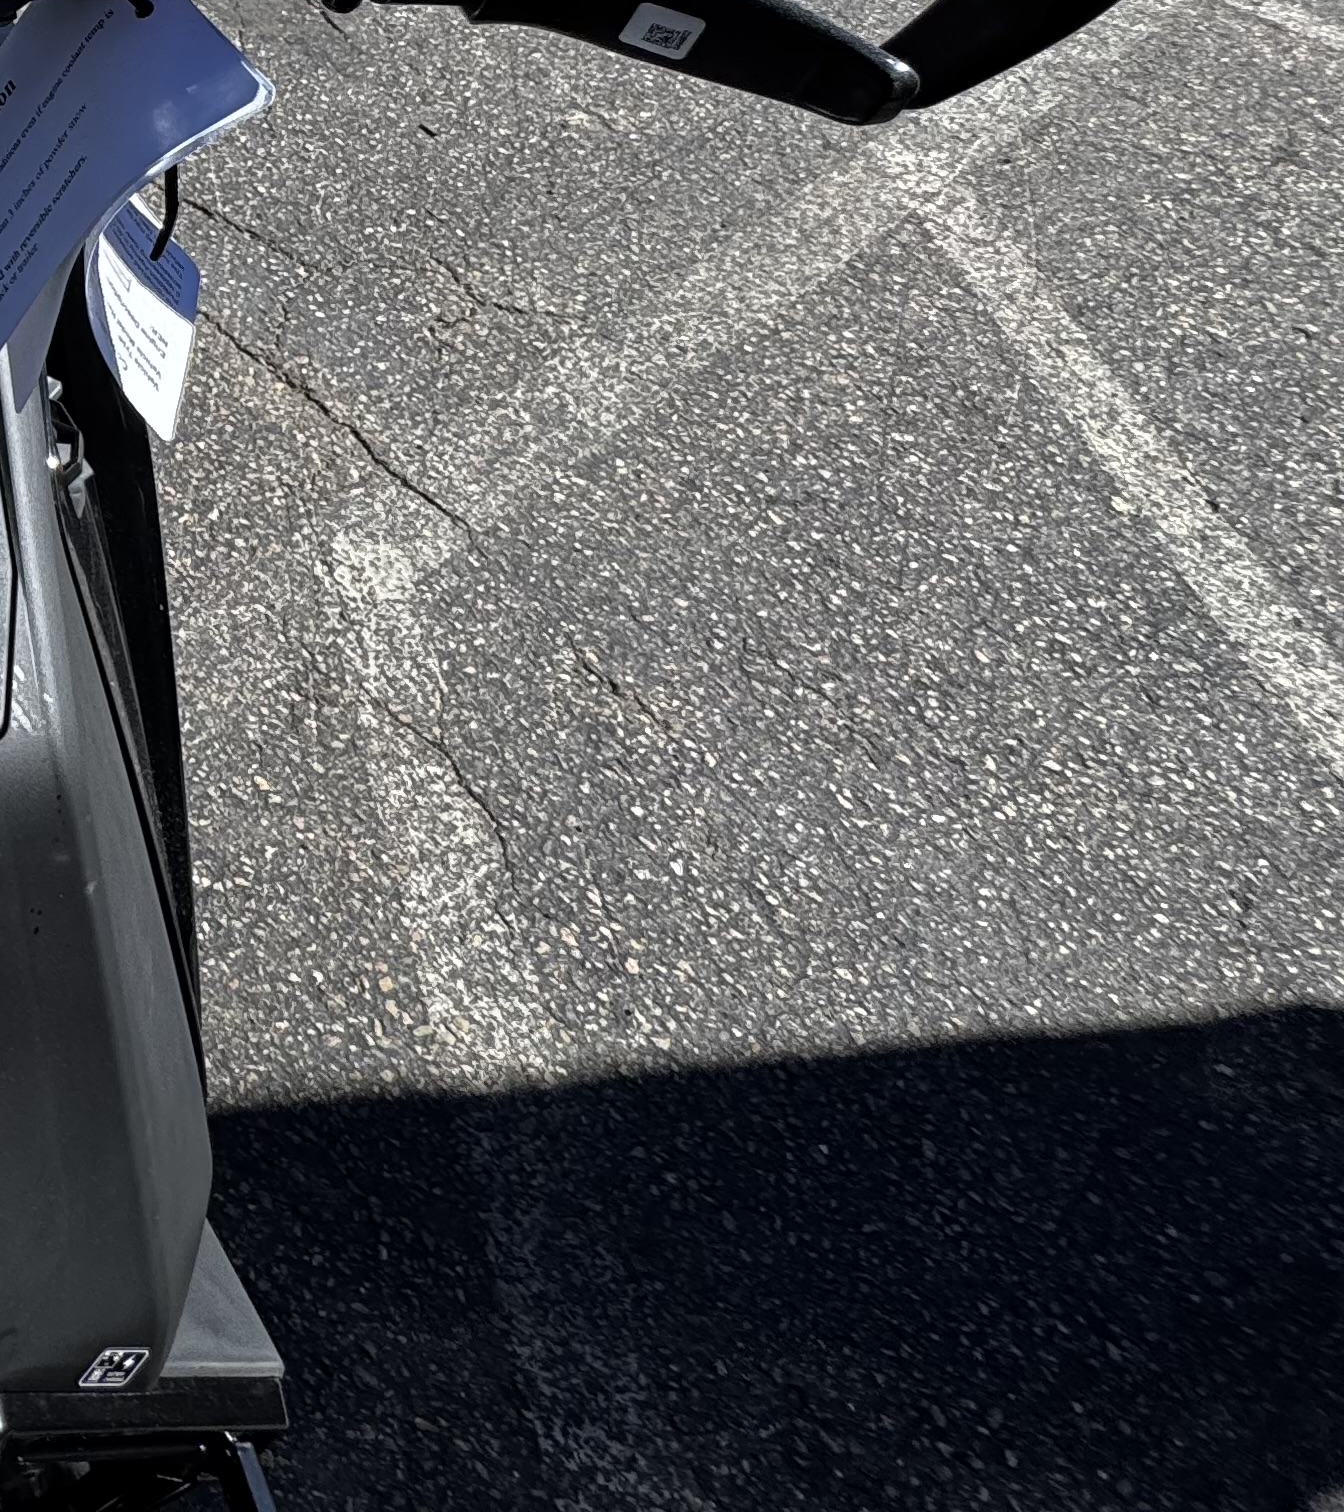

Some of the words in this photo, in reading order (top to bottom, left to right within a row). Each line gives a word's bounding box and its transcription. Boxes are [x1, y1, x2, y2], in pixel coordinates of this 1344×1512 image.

[19, 117, 37, 138] even
[41, 77, 64, 108] engine
[60, 41, 88, 76] coolant
[82, 18, 107, 42] temp
[101, 8, 115, 18] is
[4, 249, 21, 271] with
[19, 203, 53, 251] reversible
[50, 154, 87, 205] scratchers.
[11, 179, 36, 210] inches
[33, 163, 47, 180] of
[42, 130, 69, 169] powder
[67, 102, 89, 129] snow
